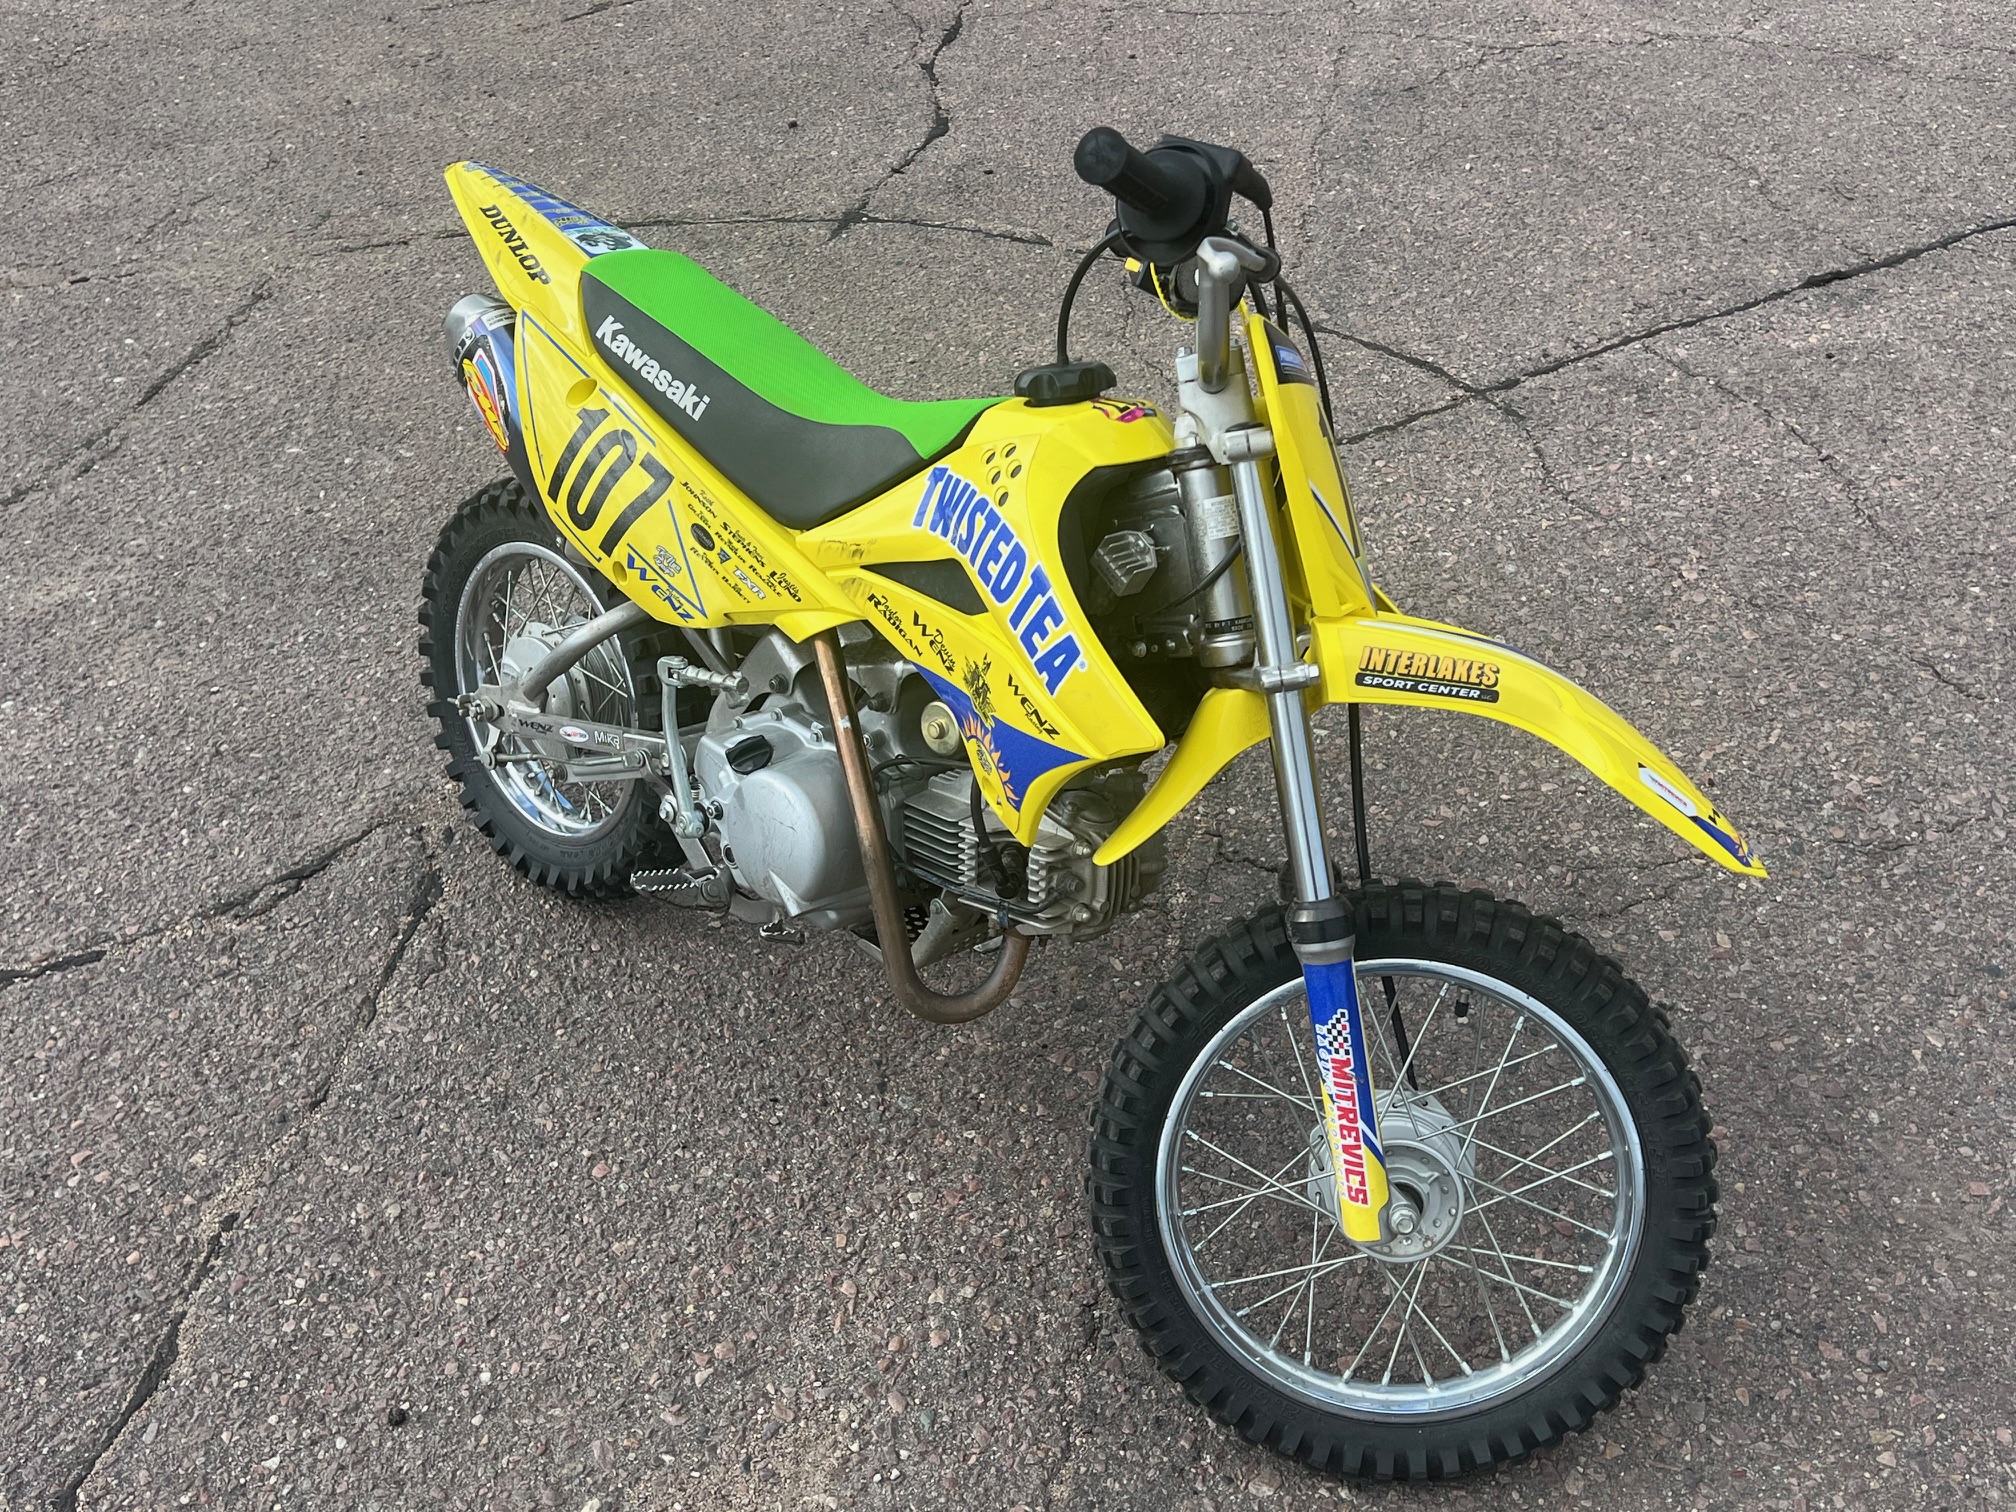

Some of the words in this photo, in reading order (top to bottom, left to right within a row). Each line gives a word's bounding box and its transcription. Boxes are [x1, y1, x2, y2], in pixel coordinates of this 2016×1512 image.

[479, 204, 552, 285] DUNLOP
[595, 314, 711, 421] Kawasaki
[547, 408, 675, 558] 107
[680, 481, 717, 518] JOHNSON
[720, 522, 766, 568] STEPHENS
[627, 552, 695, 623] WENZ
[733, 565, 766, 600] FXR
[769, 570, 802, 602] LUND
[881, 595, 902, 625] Taylor
[913, 466, 1028, 605] TWISTED
[1009, 564, 1081, 696] TEA
[867, 593, 923, 657] RADIGAN
[913, 610, 955, 676] WENZ
[1359, 645, 1500, 688] INTERLAKES
[1363, 676, 1415, 690] SPORT
[1417, 682, 1480, 699] CENTER
[518, 718, 554, 733] WENZ
[1008, 673, 1060, 740] WENZ
[1316, 1024, 1331, 1094] RACING
[1327, 1105, 1347, 1199] PRODUCTS
[1330, 1057, 1369, 1206] MITREVICS
